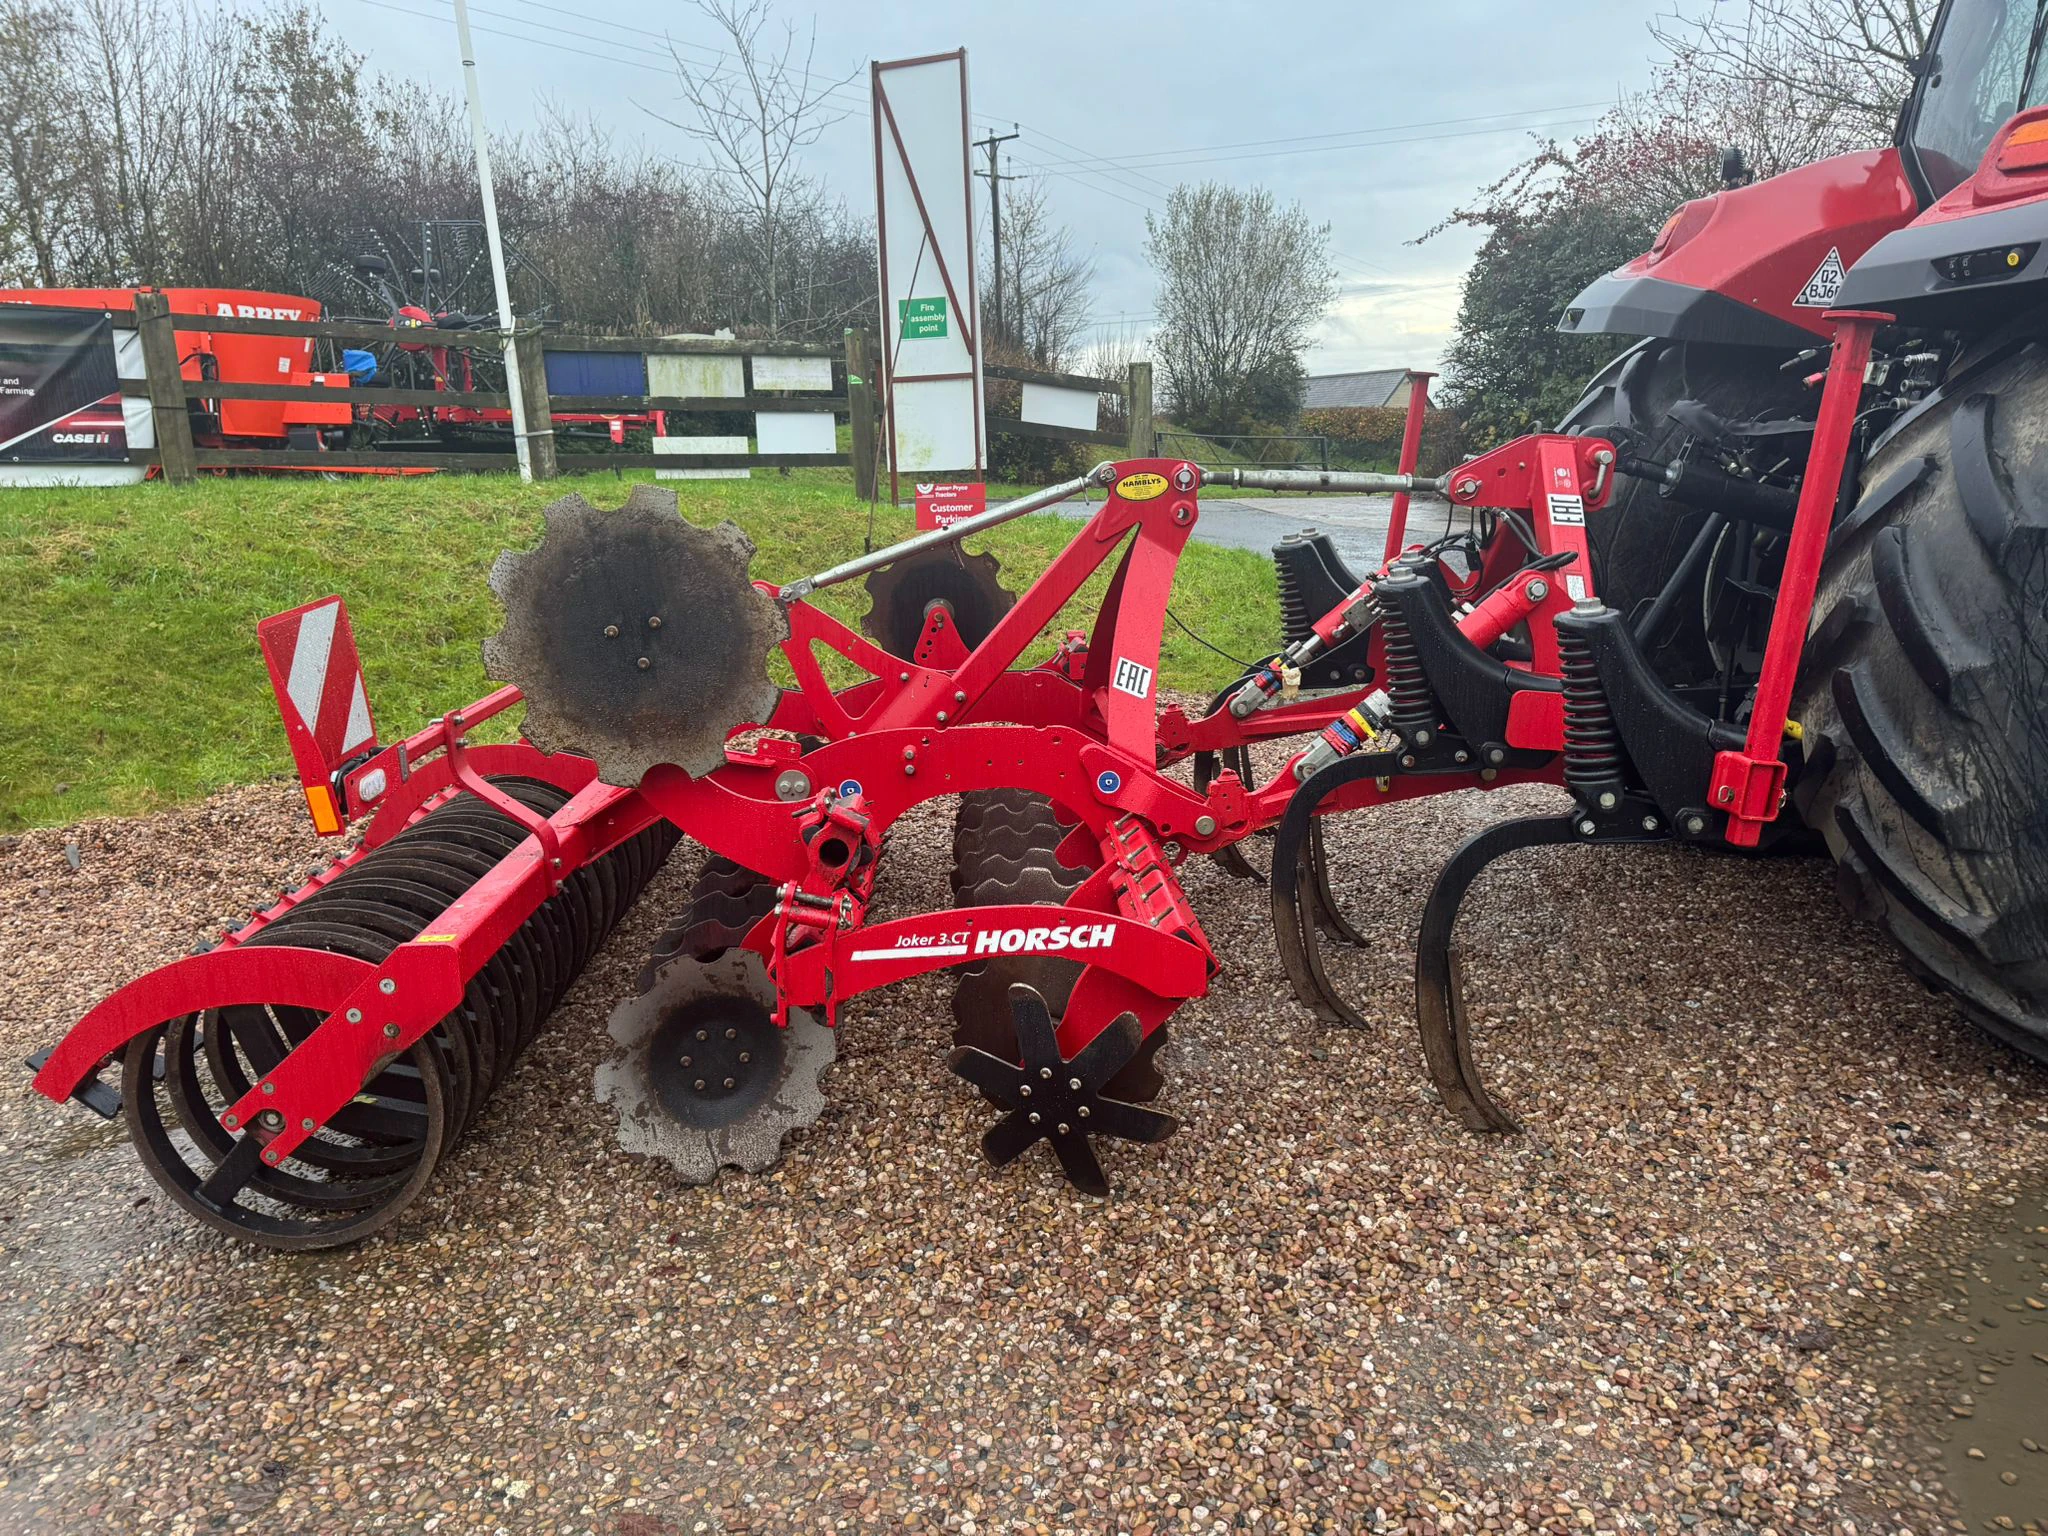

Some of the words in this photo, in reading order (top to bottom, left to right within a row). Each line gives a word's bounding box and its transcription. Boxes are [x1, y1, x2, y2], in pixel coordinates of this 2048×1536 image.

[1821, 269, 1838, 284] 02
[920, 303, 935, 312] Fire
[910, 313, 946, 323] assembly
[919, 324, 939, 334] point
[3, 377, 19, 385] and
[0, 386, 35, 397] Farming
[52, 433, 94, 444] CASE
[1122, 477, 1161, 488] HAMBLYS
[929, 503, 974, 513] Customer
[1116, 659, 1150, 695] EAC
[894, 933, 936, 948] Joker
[973, 923, 1117, 955] HORSCH
